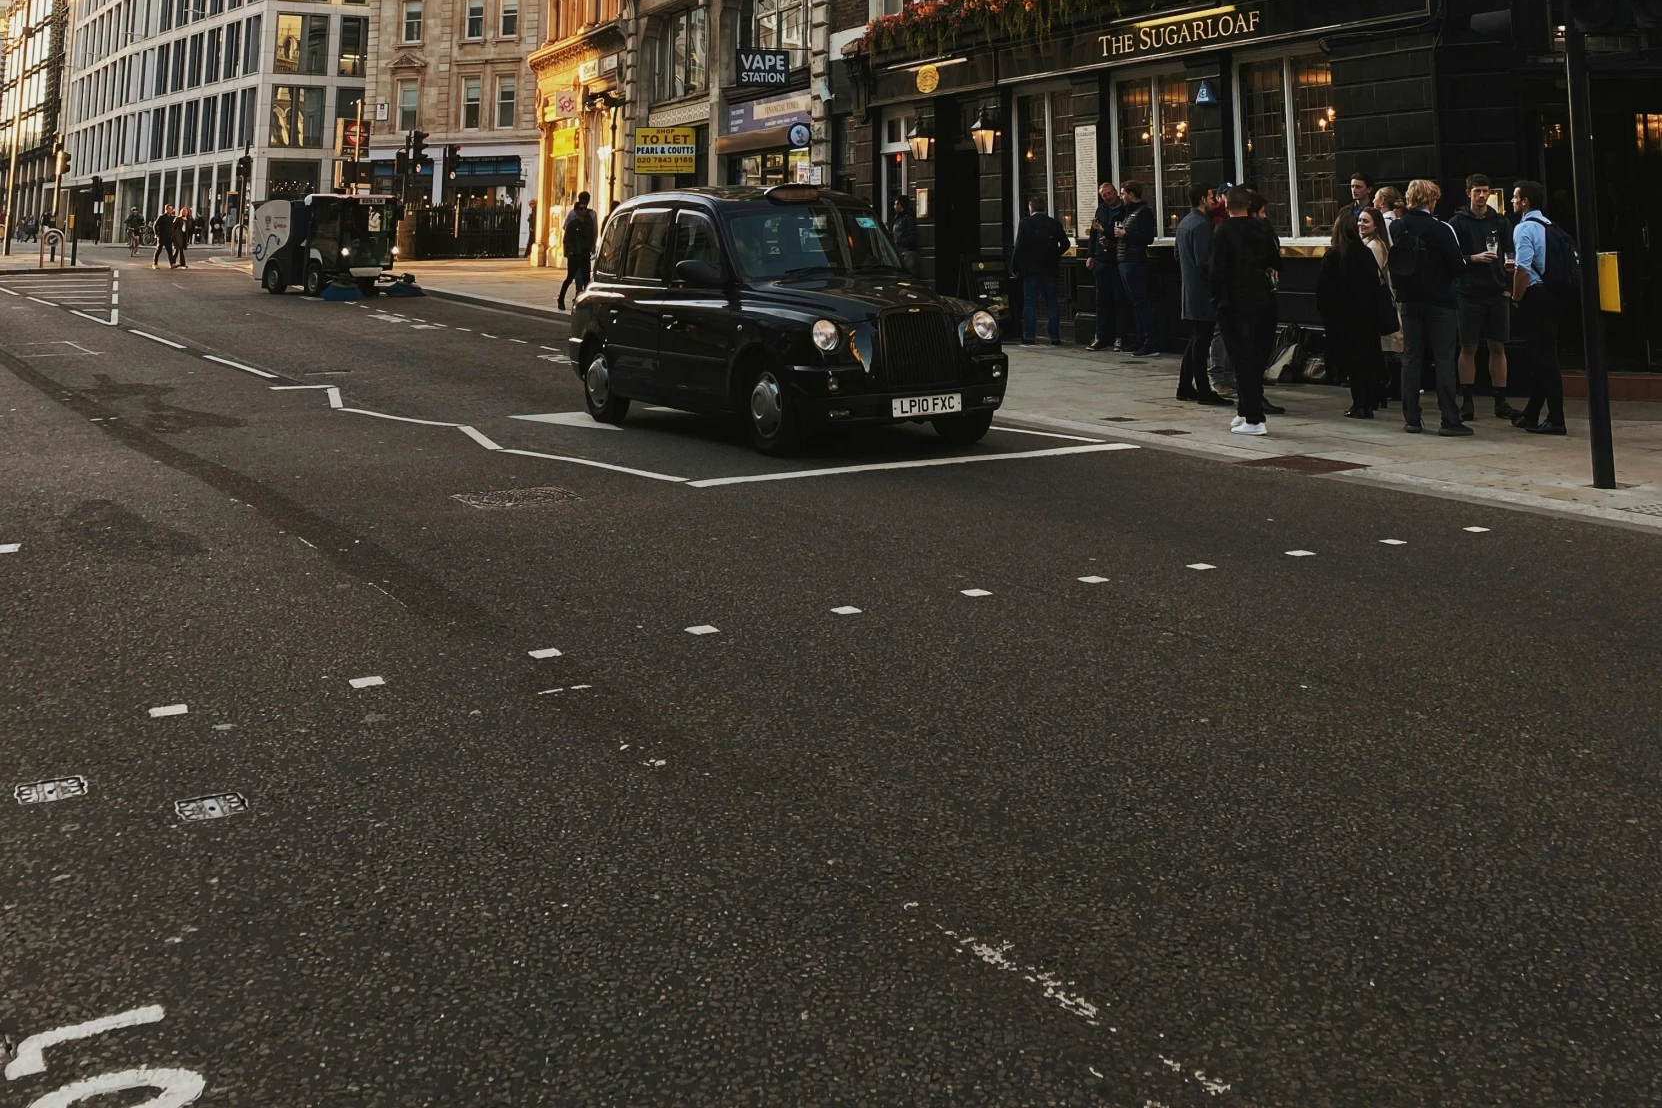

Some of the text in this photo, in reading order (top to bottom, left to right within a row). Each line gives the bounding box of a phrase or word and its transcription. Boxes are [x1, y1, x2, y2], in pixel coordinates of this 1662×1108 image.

[1098, 10, 1260, 57] THE SUGARLOAF
[741, 54, 785, 70] VAPE
[742, 72, 786, 83] STATION
[641, 135, 690, 145] TO LET
[660, 146, 665, 154] &
[667, 146, 694, 154] COUTTS
[900, 395, 955, 414] LP10 FXC
